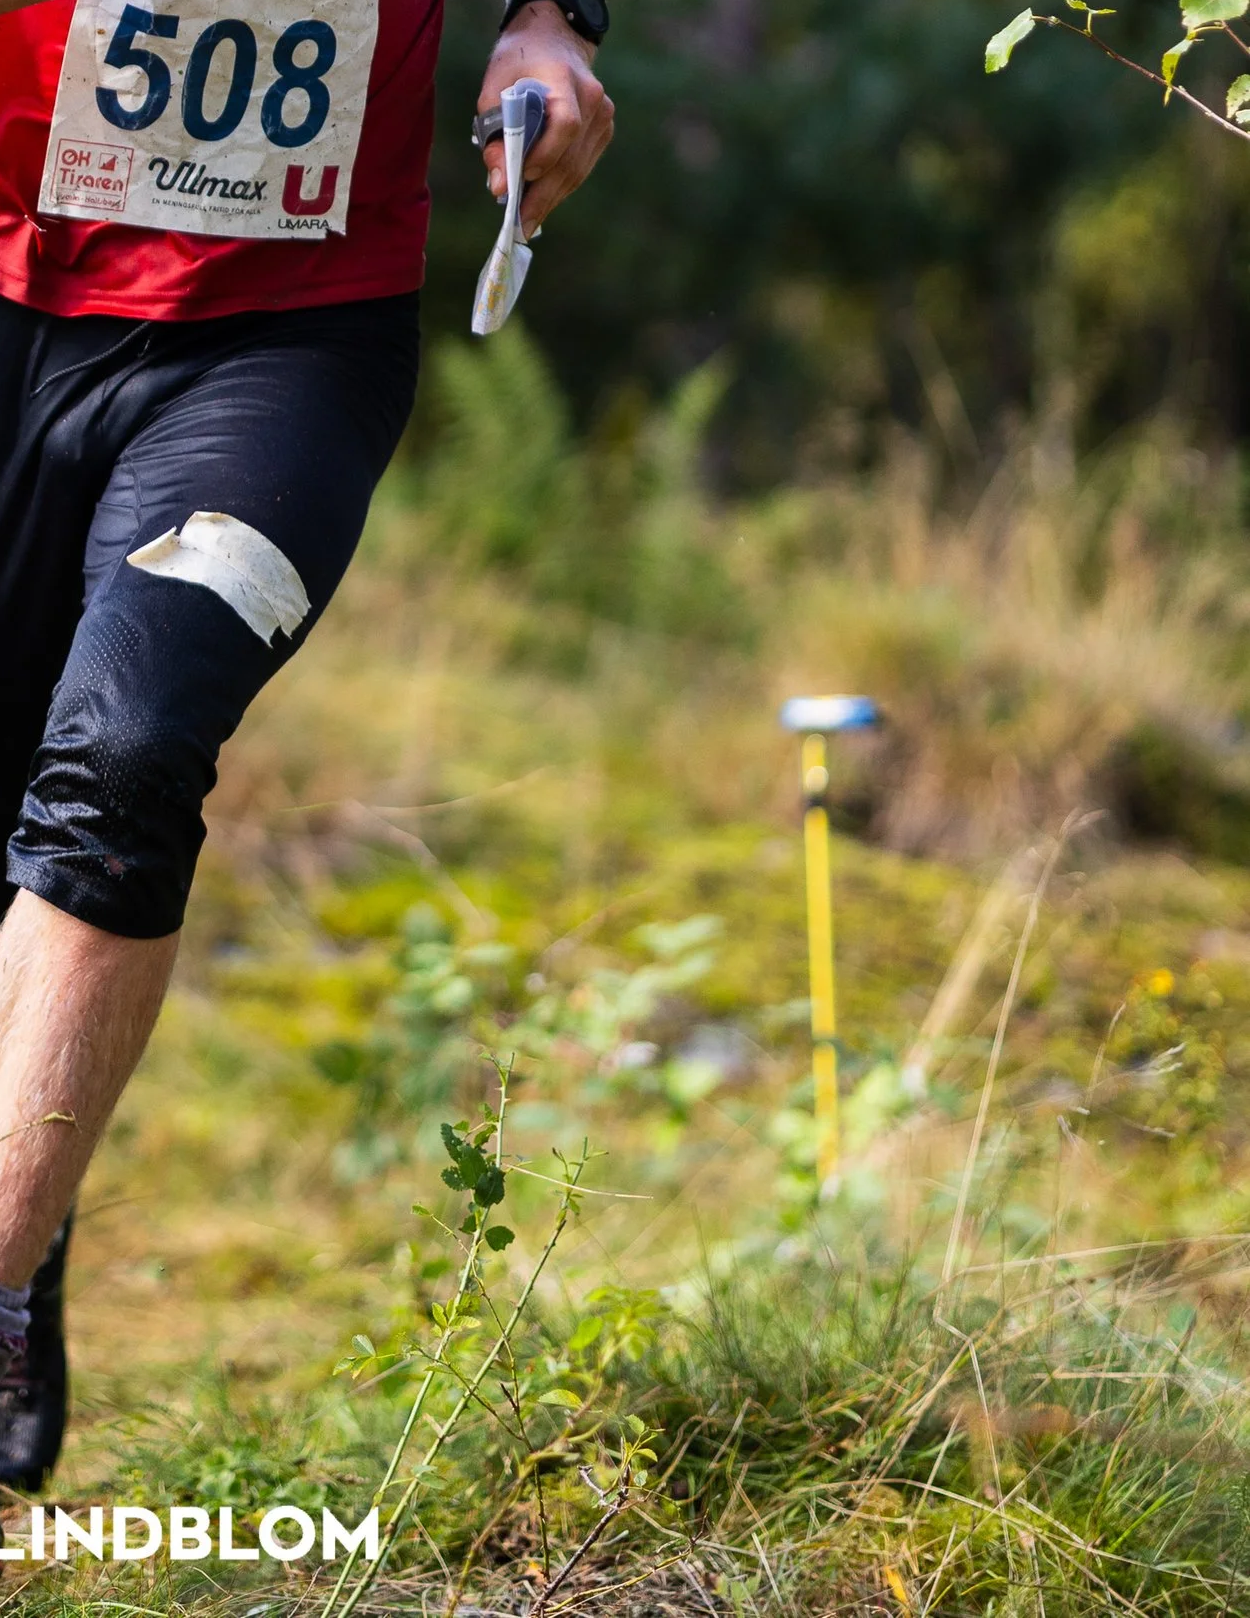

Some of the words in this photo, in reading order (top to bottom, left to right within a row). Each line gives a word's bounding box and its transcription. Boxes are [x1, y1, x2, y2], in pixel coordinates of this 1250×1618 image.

[95, 3, 337, 148] 508
[148, 157, 268, 201] Ullmax
[277, 218, 331, 230] UMARA
